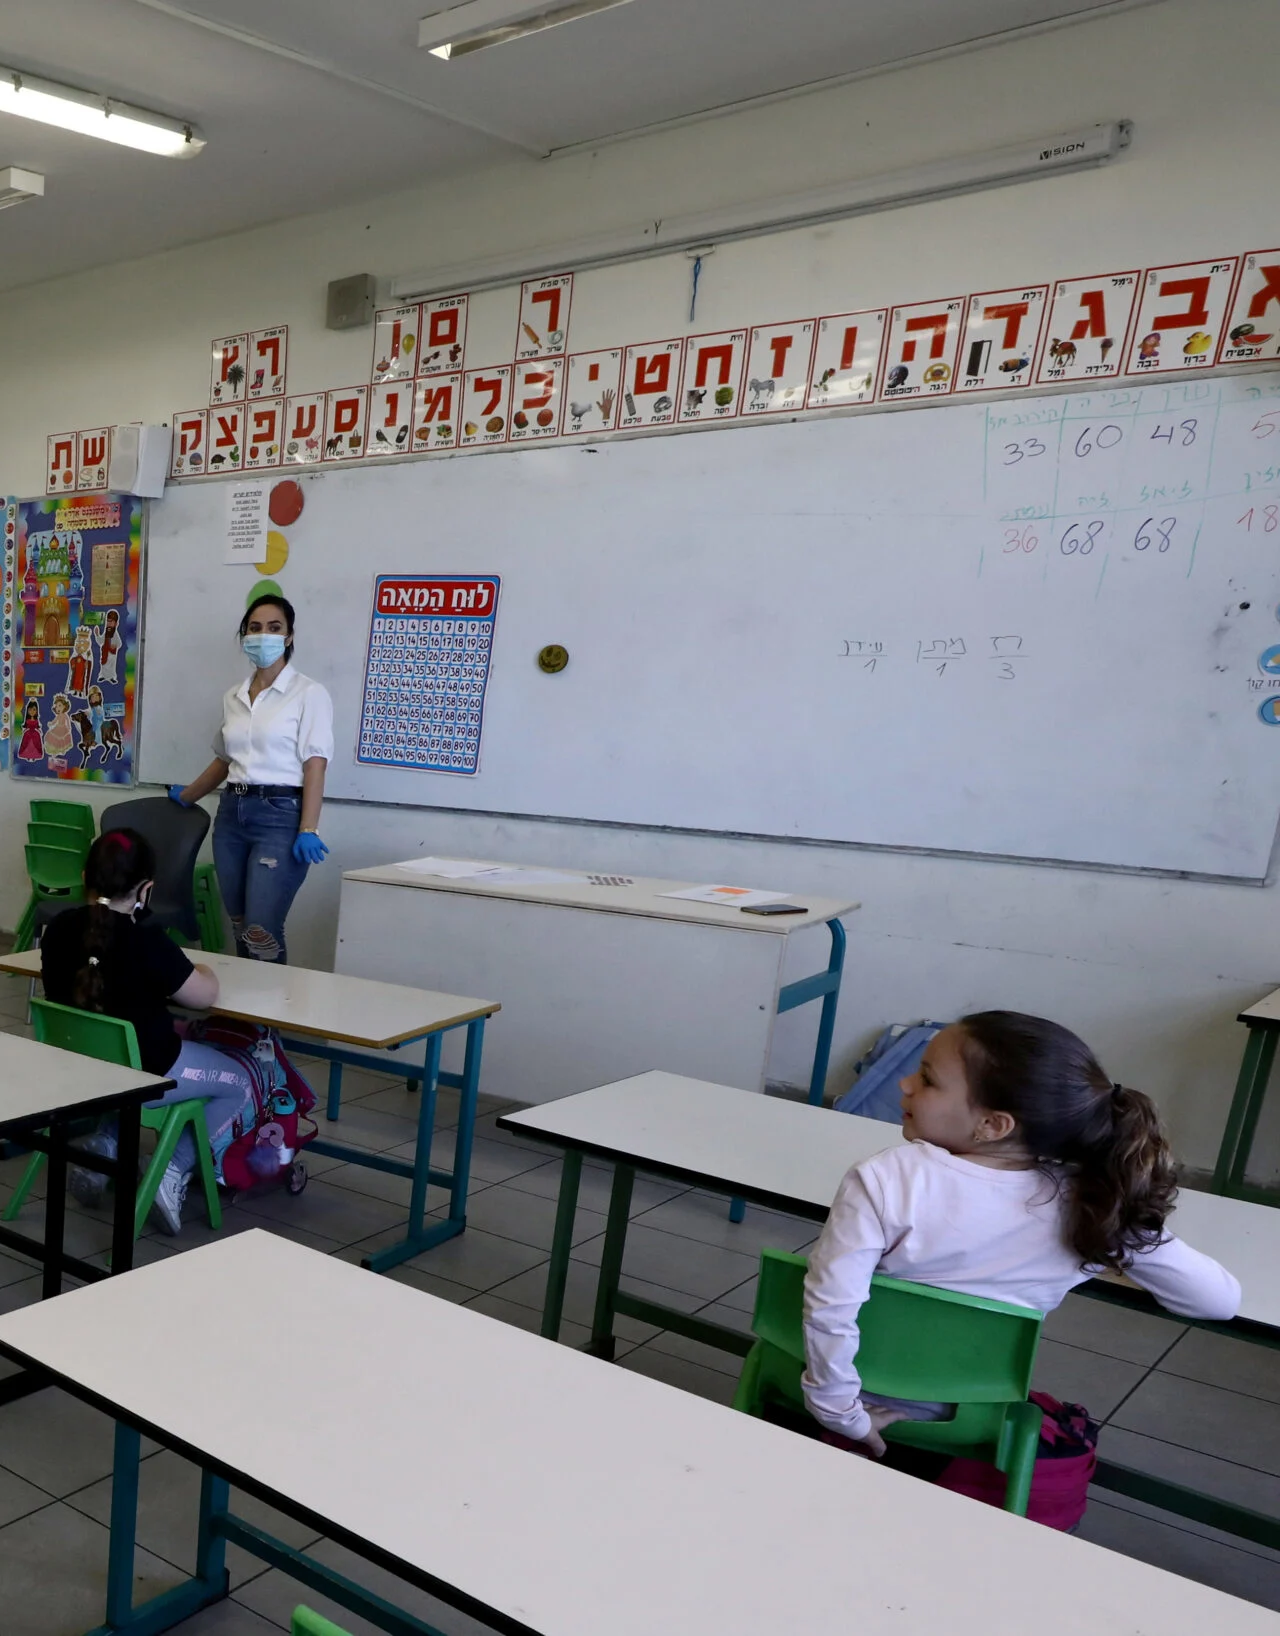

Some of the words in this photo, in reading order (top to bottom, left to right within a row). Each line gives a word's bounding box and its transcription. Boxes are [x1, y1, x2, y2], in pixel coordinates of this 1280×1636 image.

[1111, 277, 1133, 287] גימל
[1210, 263, 1231, 274] בית
[1021, 291, 1043, 301] דלת
[1152, 276, 1211, 331] ב
[983, 302, 1029, 350] ד
[1070, 290, 1106, 340] ג
[901, 313, 949, 363] ה
[1225, 347, 1262, 359] אבטיח
[588, 363, 600, 382] י
[695, 343, 733, 388] ח
[770, 335, 793, 378] ז
[1085, 364, 1114, 374] גלידה
[633, 353, 671, 396] ט
[929, 383, 947, 392] הגה
[964, 378, 985, 387] דלת
[1047, 369, 1066, 378] גמל
[423, 385, 453, 423] מ
[474, 376, 502, 416] ל
[180, 419, 202, 456] ק
[216, 414, 238, 448] צ
[252, 410, 277, 443] פ
[292, 404, 317, 439] ע
[1150, 418, 1197, 446] 48
[51, 440, 72, 471] ת
[83, 436, 105, 467] ש
[1003, 437, 1046, 466] 33
[1075, 425, 1123, 458] 60
[1003, 524, 1038, 554] 36
[1060, 520, 1104, 556] 68
[1134, 517, 1177, 553] 68
[374, 635, 381, 644] 11
[385, 635, 393, 644] 12
[396, 635, 404, 645] 13
[407, 636, 416, 645] 14
[419, 636, 428, 646] 15
[431, 637, 439, 646] 16
[443, 637, 451, 646] 17
[455, 638, 463, 647] 18
[467, 639, 476, 648] 19
[478, 639, 489, 649] 20
[377, 621, 381, 630] 1
[388, 621, 394, 630] 2
[399, 621, 405, 630] 3
[410, 622, 416, 631] 4
[422, 622, 428, 631] 5
[434, 622, 439, 631] 6
[446, 623, 451, 632] 7
[457, 623, 463, 633] 8
[470, 624, 476, 633] 9
[481, 624, 490, 634] 10
